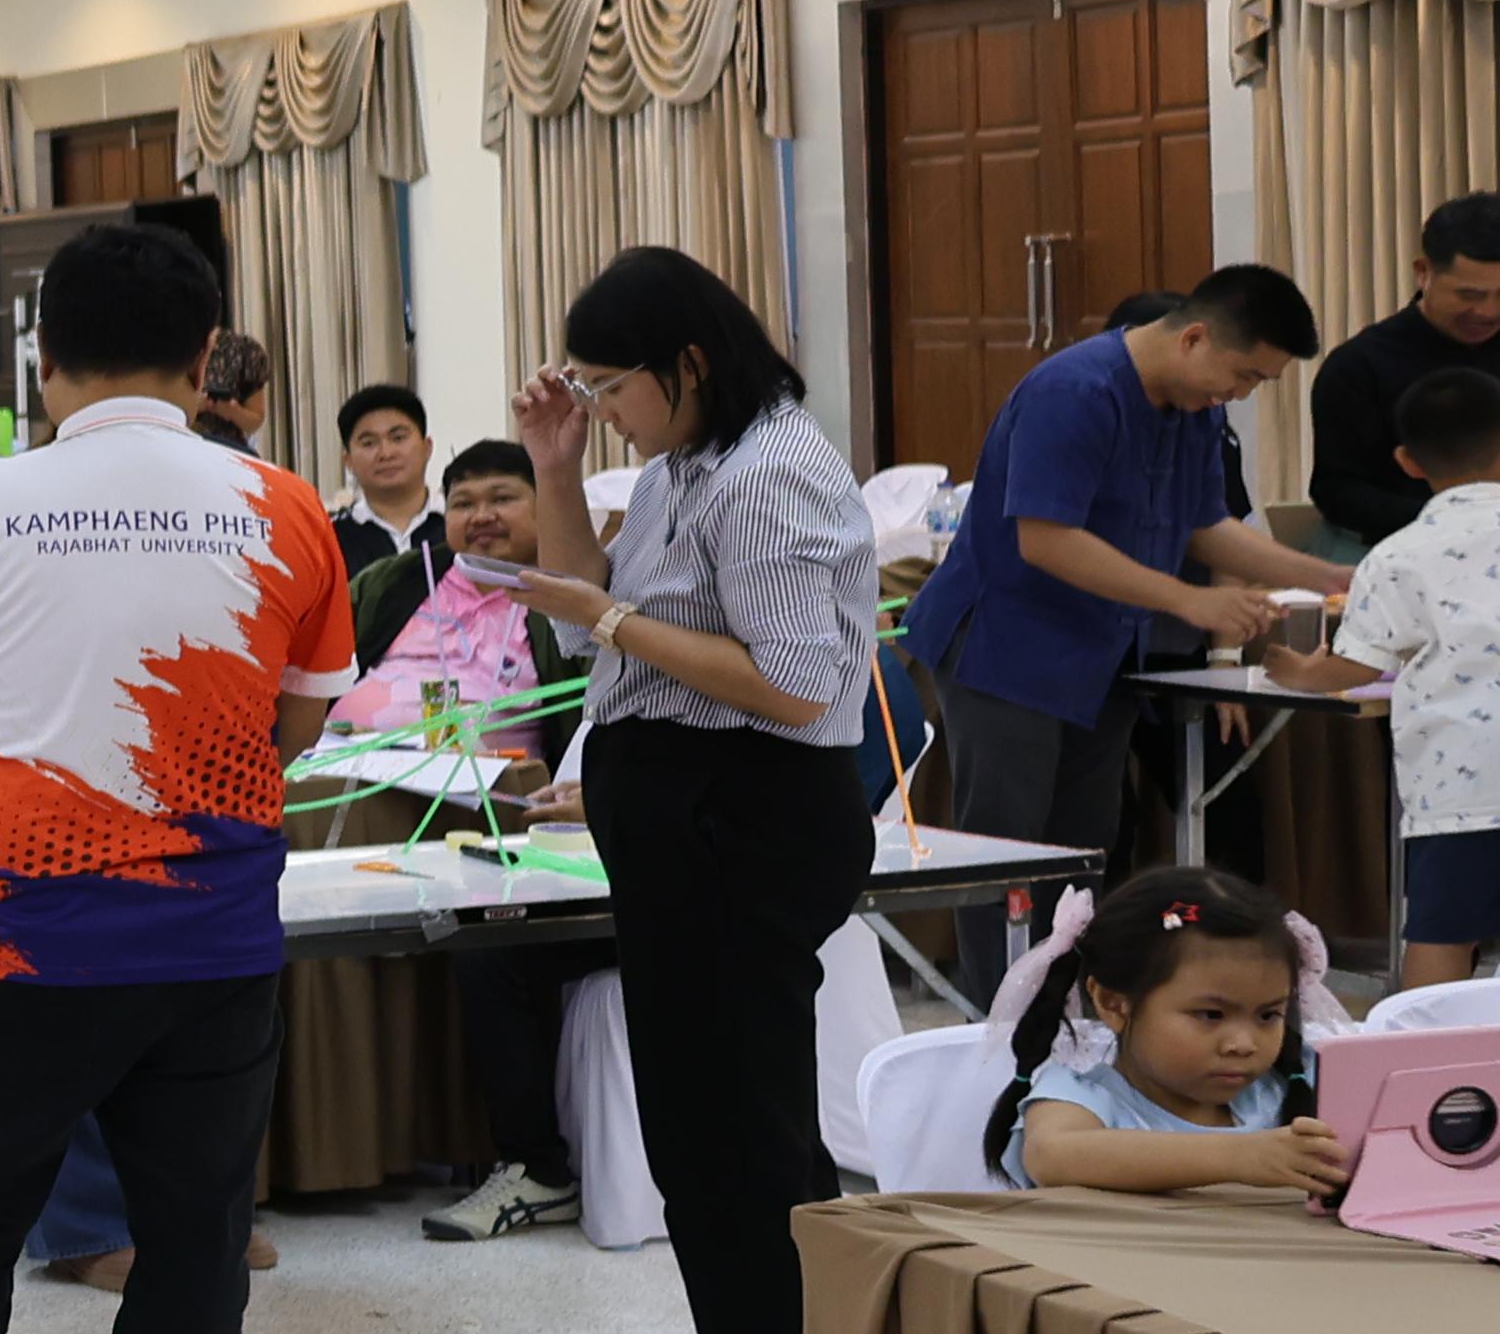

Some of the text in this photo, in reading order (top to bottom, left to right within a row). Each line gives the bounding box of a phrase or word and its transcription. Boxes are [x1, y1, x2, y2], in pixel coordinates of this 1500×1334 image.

[4, 510, 270, 540] KAMPHAENG PHET
[37, 538, 245, 557] RAJABHAT UNIVERSITY
